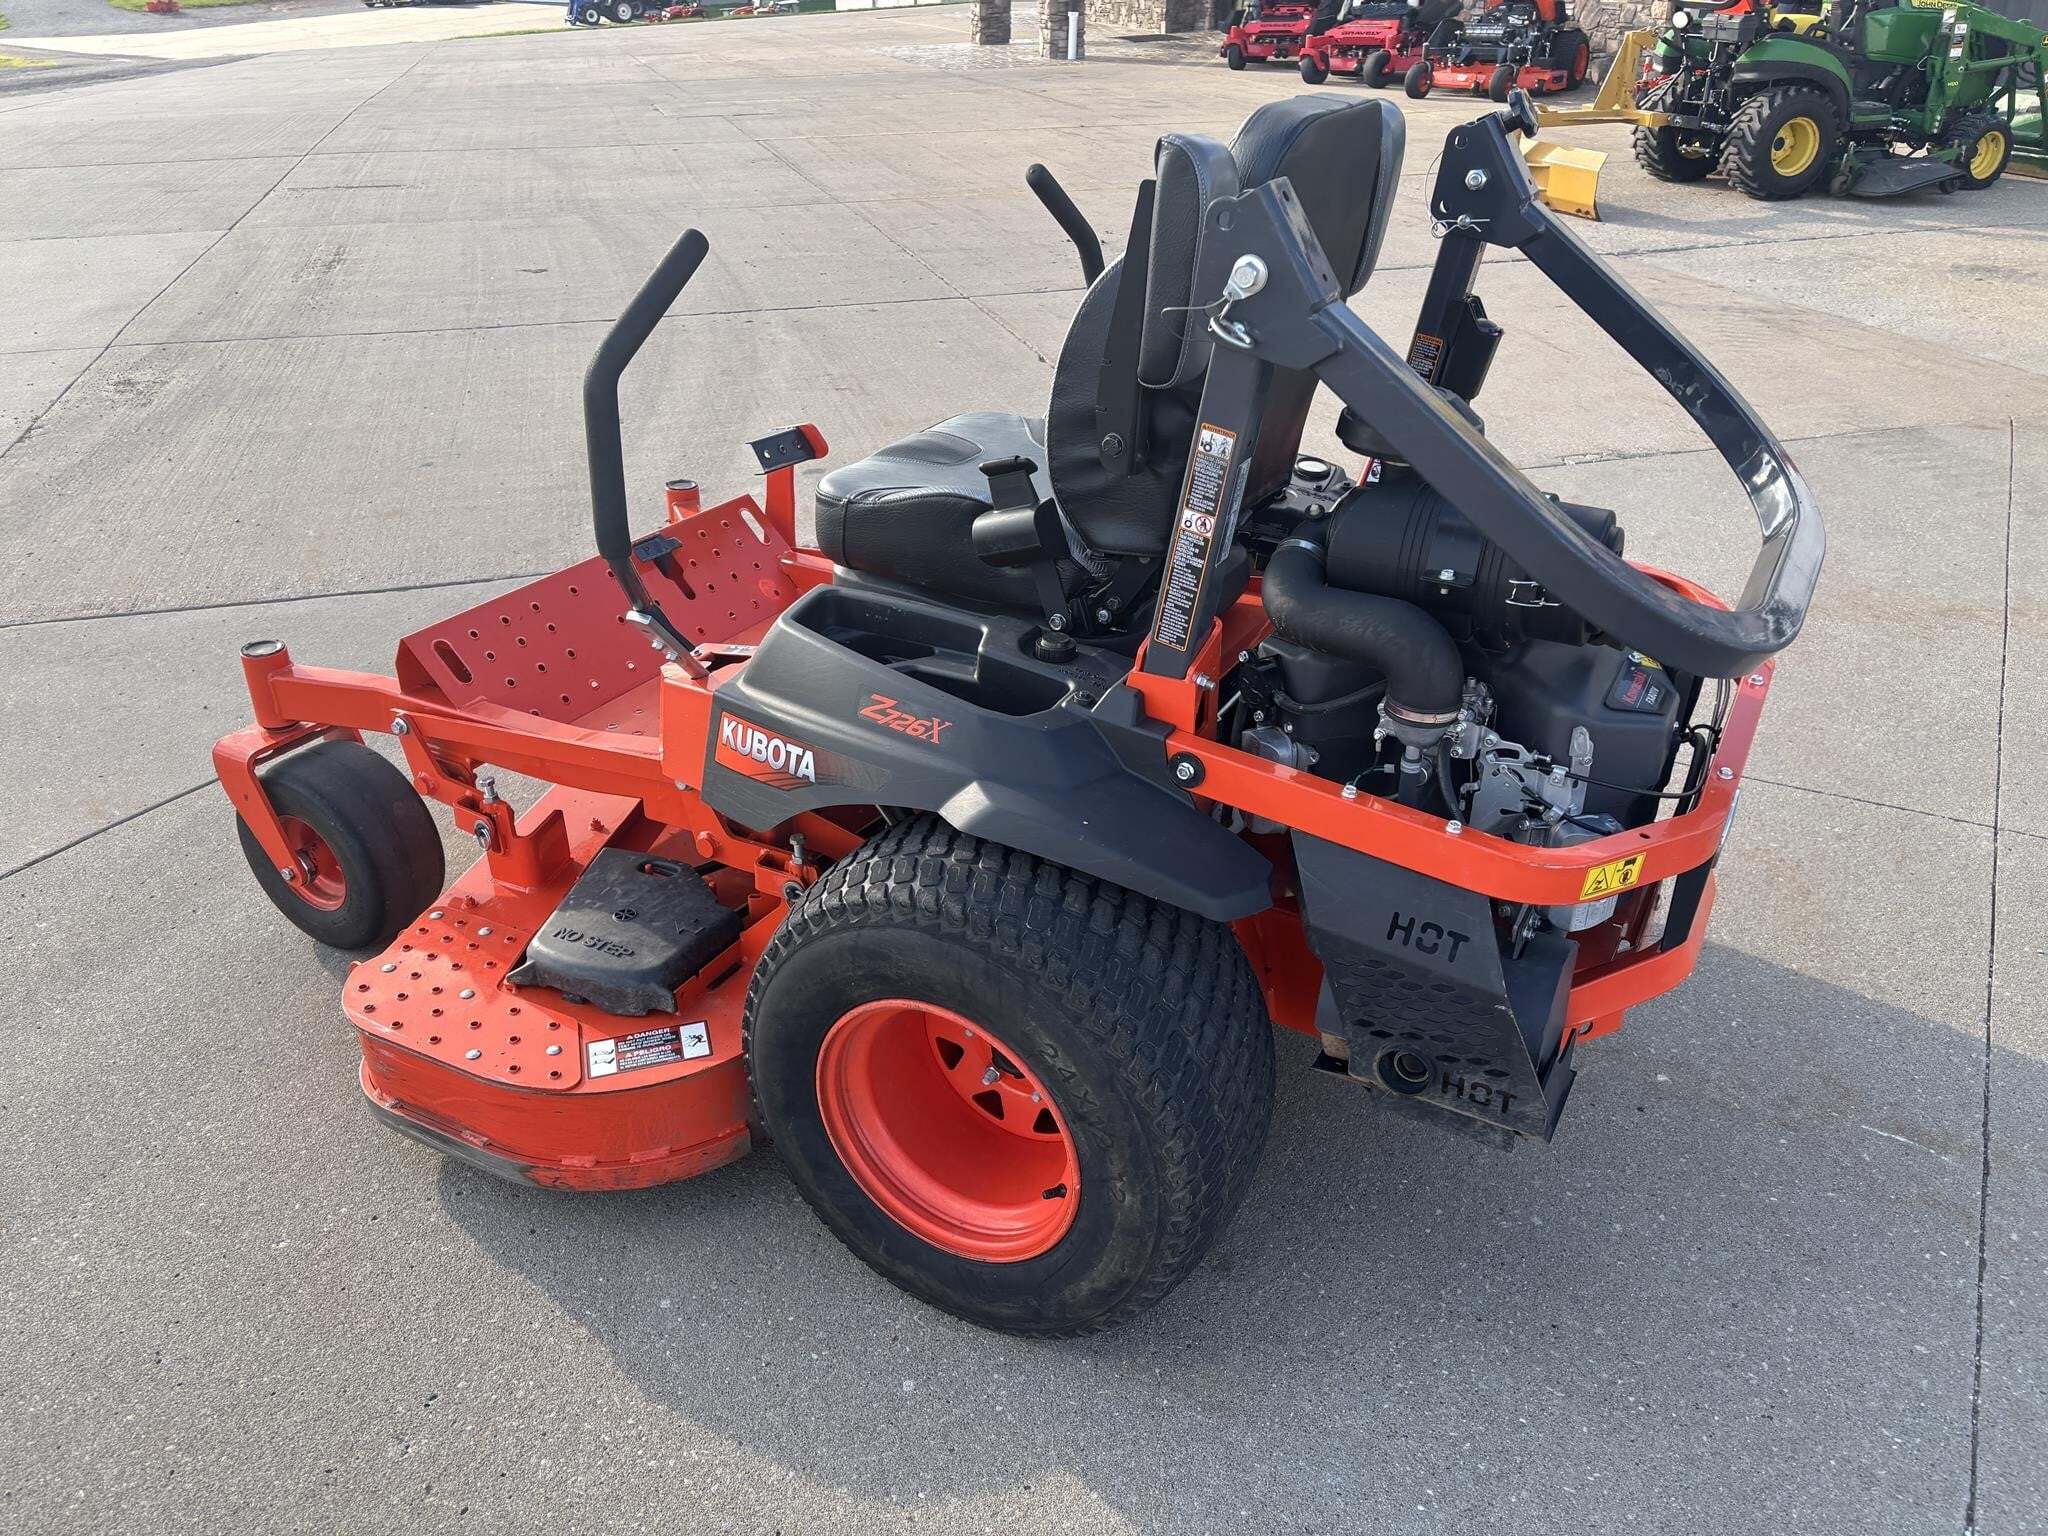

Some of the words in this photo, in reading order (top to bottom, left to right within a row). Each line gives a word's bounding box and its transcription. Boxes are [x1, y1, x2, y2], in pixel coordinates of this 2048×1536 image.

[859, 693, 952, 745] Z726X
[721, 716, 816, 784] KUBOTA
[552, 927, 584, 942] NO
[582, 936, 636, 957] STEP
[1386, 911, 1471, 963] HOT
[633, 1045, 672, 1056] PELIGRO
[634, 1027, 670, 1039] DANGER
[1440, 1071, 1518, 1114] HOT
